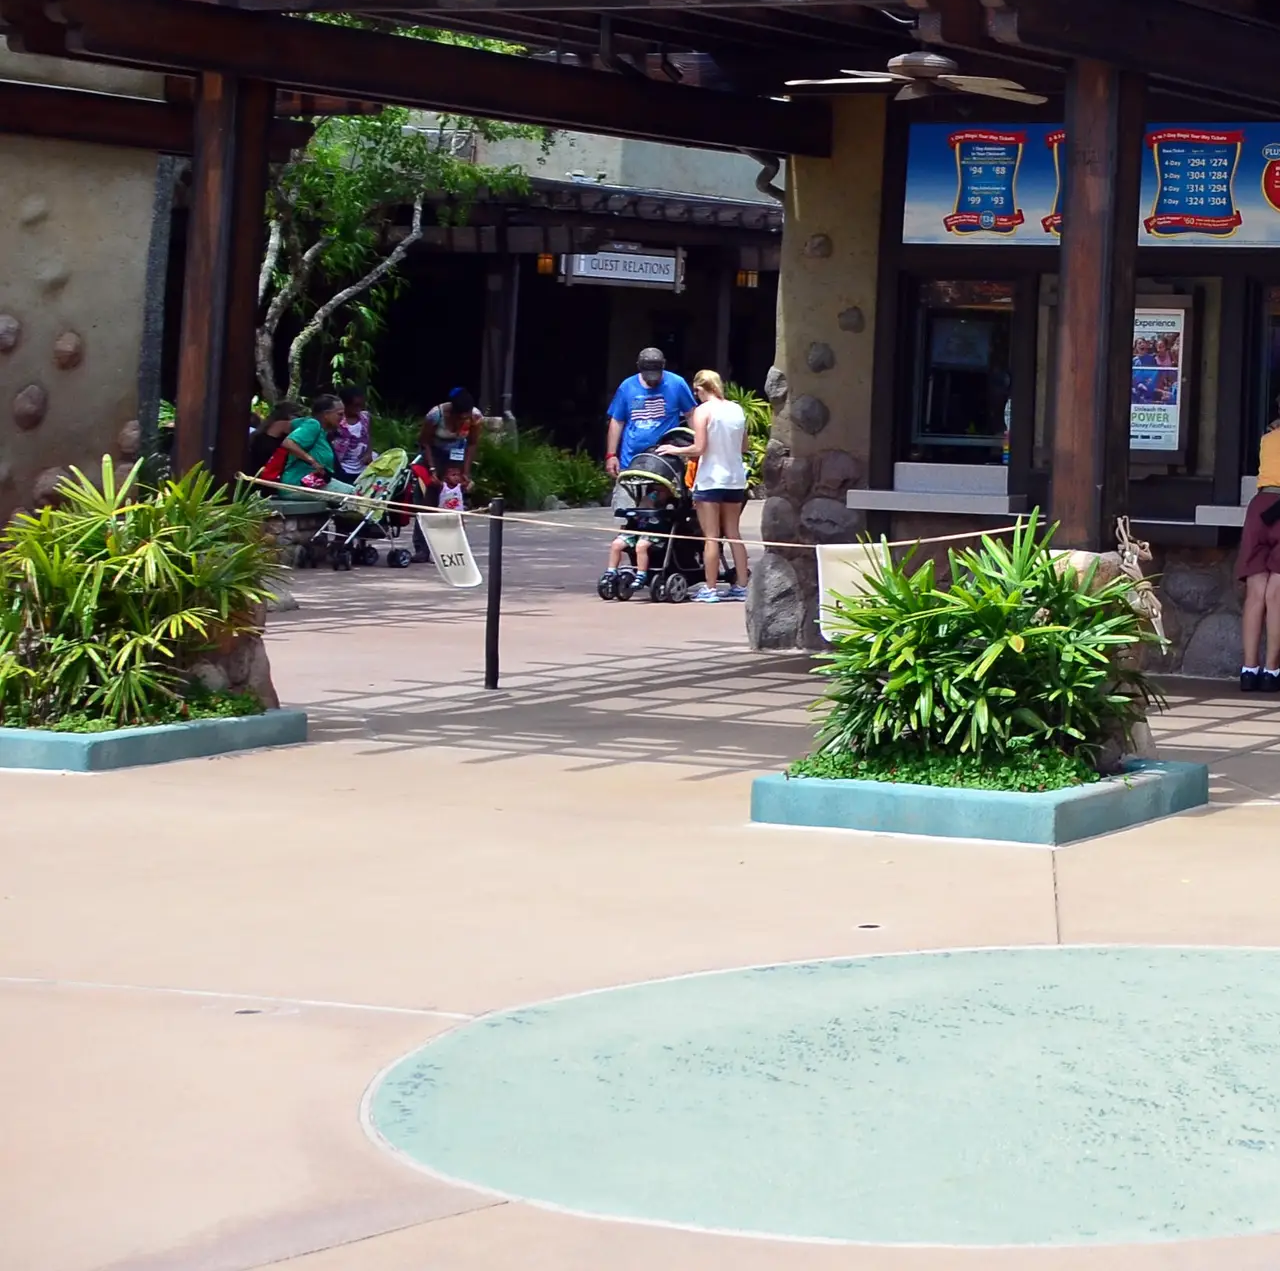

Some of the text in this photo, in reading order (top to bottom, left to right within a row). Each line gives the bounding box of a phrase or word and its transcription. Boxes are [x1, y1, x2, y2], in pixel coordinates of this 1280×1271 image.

[591, 259, 670, 275] GUEST RELATIONS
[1135, 319, 1176, 327] Experience
[1132, 413, 1169, 422] POWER
[441, 554, 465, 567] EXIT
